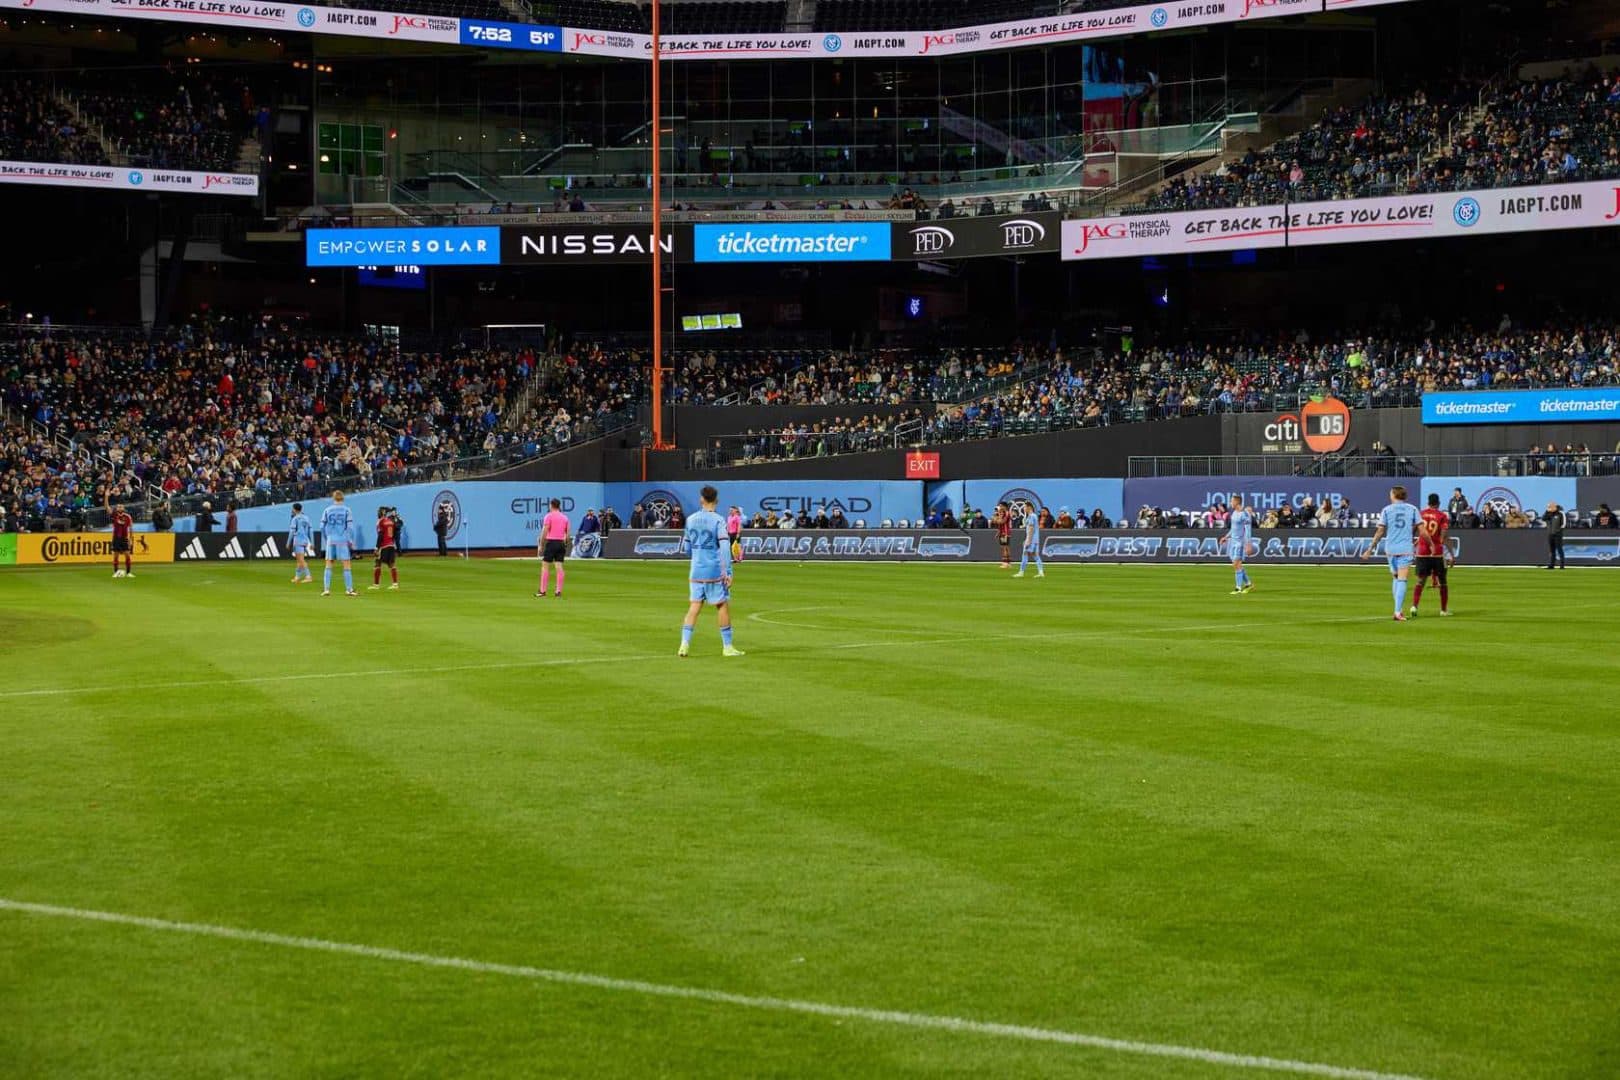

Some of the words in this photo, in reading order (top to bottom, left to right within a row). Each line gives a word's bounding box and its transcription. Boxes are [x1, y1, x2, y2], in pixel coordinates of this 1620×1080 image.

[174, 1, 195, 10] THE
[199, 2, 226, 12] LIFE
[229, 5, 250, 14] YOU
[254, 7, 286, 17] LOVE!
[1178, 4, 1225, 18] JAGPT.COM
[327, 12, 377, 26] JAGPT.COM
[389, 15, 427, 34] JAG
[428, 18, 457, 26] PHYSICAL
[990, 28, 1009, 40] GET
[1011, 26, 1037, 37] BACK
[1040, 23, 1059, 33] THE
[1062, 20, 1083, 31] LIFE
[1087, 18, 1106, 28] YOU
[1108, 14, 1136, 26] LOVE!
[469, 25, 512, 42] 7:52
[570, 32, 605, 51] JAG
[607, 35, 634, 43] PHYSICAL
[955, 31, 980, 39] PHYSICAL
[955, 35, 981, 44] THERAPY
[607, 41, 634, 49] THERAPY
[644, 40, 665, 50] GT
[668, 40, 699, 50] BACK
[702, 40, 723, 50] THE
[726, 39, 752, 49] LIFE
[756, 39, 776, 49] YOU
[780, 39, 811, 49] LOVE!
[854, 38, 905, 49] JAGPT.COM
[918, 34, 954, 54] JAG
[28, 167, 45, 175] THE
[47, 168, 67, 177] LIFE
[70, 170, 88, 178] YOU
[90, 171, 114, 179] LOVE!
[153, 174, 192, 184] JAGPT.COM
[1499, 194, 1582, 215] JAGPT.COM
[1129, 219, 1170, 230] PHYSICAL
[1184, 219, 1217, 234] GET
[1221, 217, 1262, 231] BACK
[1268, 213, 1301, 228] THE
[1307, 210, 1343, 226] LIFE
[1350, 207, 1381, 223] YOU
[1386, 204, 1434, 221] LOVE!
[915, 231, 944, 252] PFD
[1004, 226, 1034, 247] PFD
[1074, 223, 1126, 254] JAG
[1130, 228, 1171, 239] THERAPY
[411, 239, 488, 253] SOLAR
[521, 233, 673, 255] NISSAN
[1540, 398, 1618, 412] ticketmaster
[1264, 418, 1298, 440] citi
[1320, 415, 1343, 434] 05
[909, 460, 936, 471] EXIT
[511, 496, 575, 514] ETIHD
[759, 496, 872, 513] ETIHAD
[1250, 492, 1287, 508] THE
[1292, 492, 1342, 509] CUB
[1394, 513, 1406, 529] 5
[689, 528, 713, 549] 22
[813, 536, 832, 555] &
[833, 536, 917, 555] TRAVEL
[1098, 536, 1162, 556] BEST
[1263, 537, 1285, 557] &
[41, 536, 135, 562] Continenl
